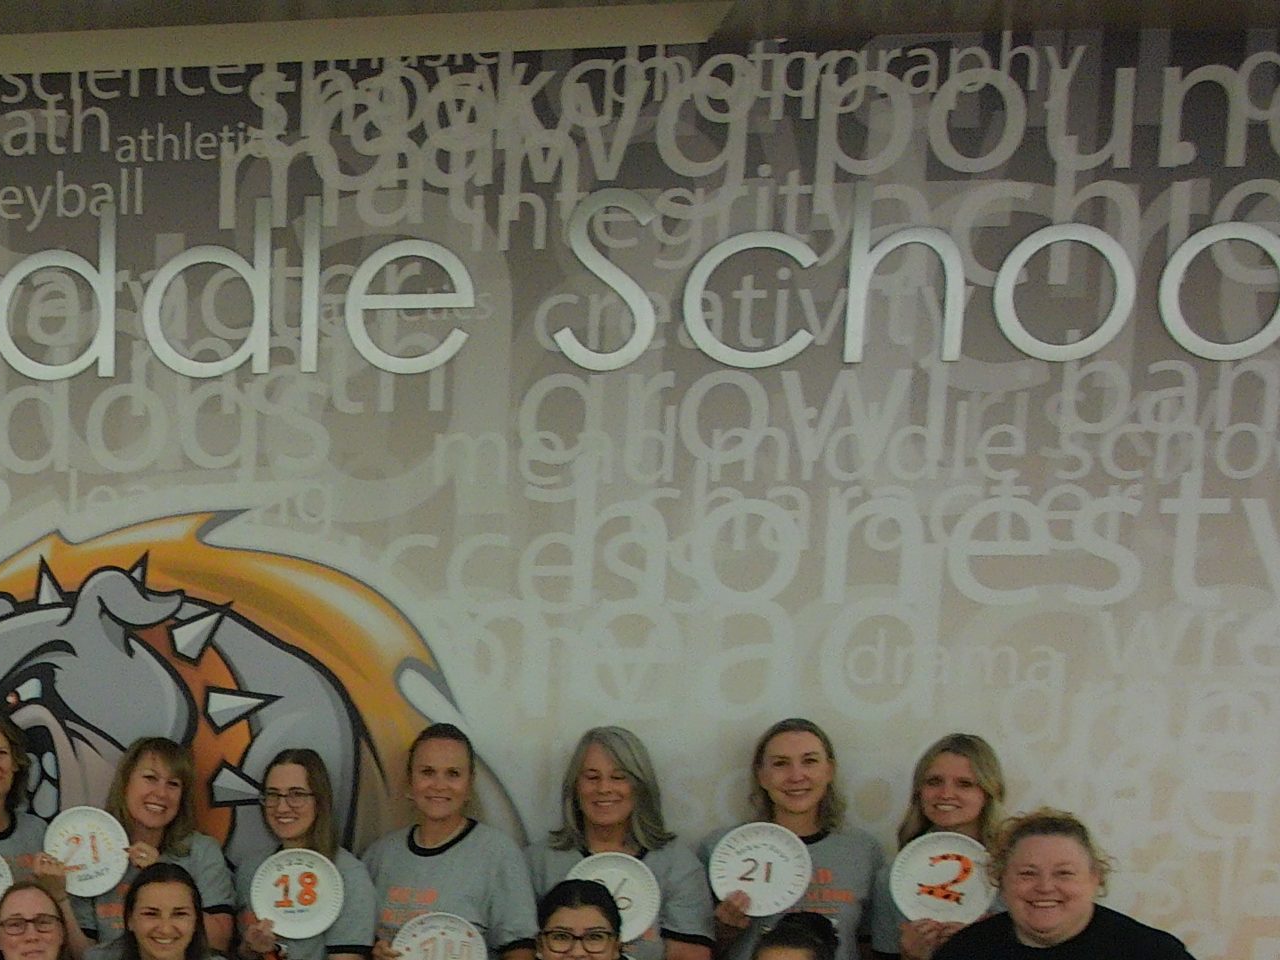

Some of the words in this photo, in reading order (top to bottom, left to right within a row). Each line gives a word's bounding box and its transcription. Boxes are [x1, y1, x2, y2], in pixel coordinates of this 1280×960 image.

[553, 183, 1280, 371] Schoo
[273, 871, 319, 908] 18
[738, 858, 773, 883] 21
[916, 853, 974, 904] 2
